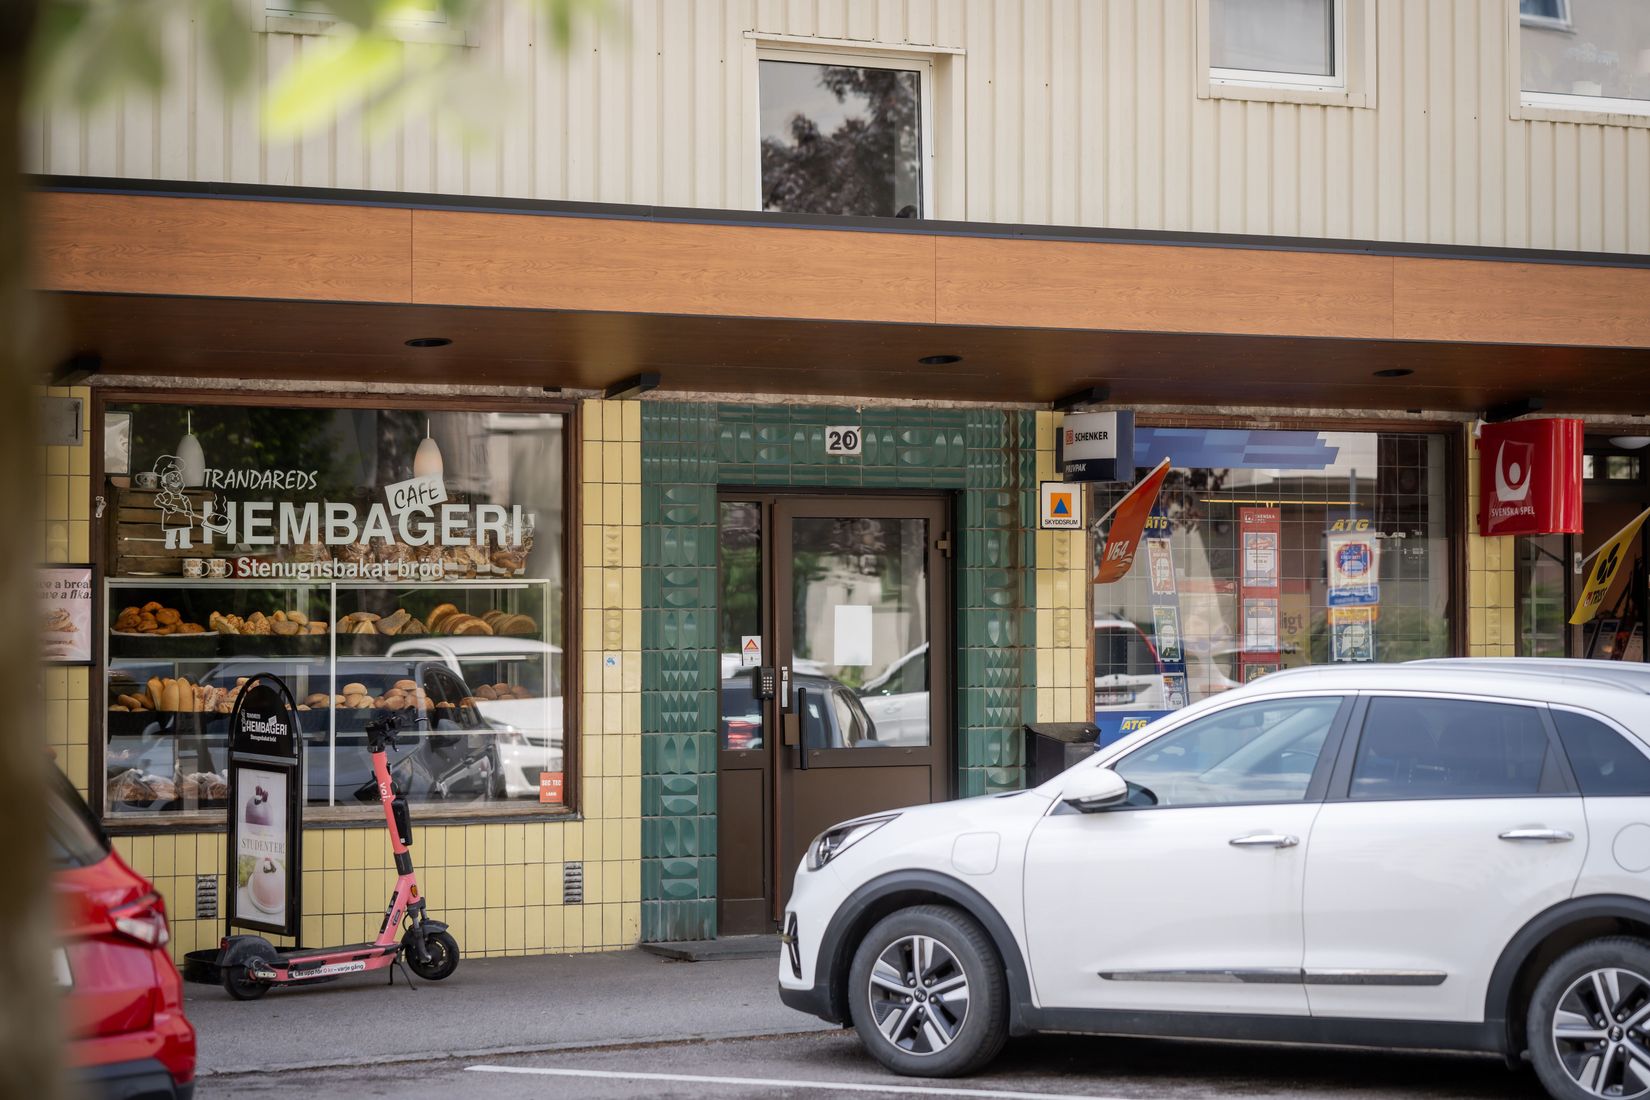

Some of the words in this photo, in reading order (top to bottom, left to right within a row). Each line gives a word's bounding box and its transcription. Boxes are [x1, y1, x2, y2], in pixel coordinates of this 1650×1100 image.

[829, 430, 858, 450] 20
[1075, 431, 1109, 442] SCHENKER
[203, 468, 319, 490] TRANDAREDS
[1491, 507, 1519, 517] SVENSKA
[1520, 505, 1536, 515] SPEL
[203, 501, 522, 546] HEMBAGERI
[1145, 516, 1168, 529] ATG
[1330, 519, 1369, 532] ATG
[1106, 541, 1130, 561] V64
[237, 556, 391, 581] Stenugnsbakat
[398, 556, 444, 578] bröd
[55, 581, 61, 589] a
[60, 591, 68, 600] a
[246, 719, 288, 736] HEMBAGERI
[1121, 719, 1148, 730] ATG
